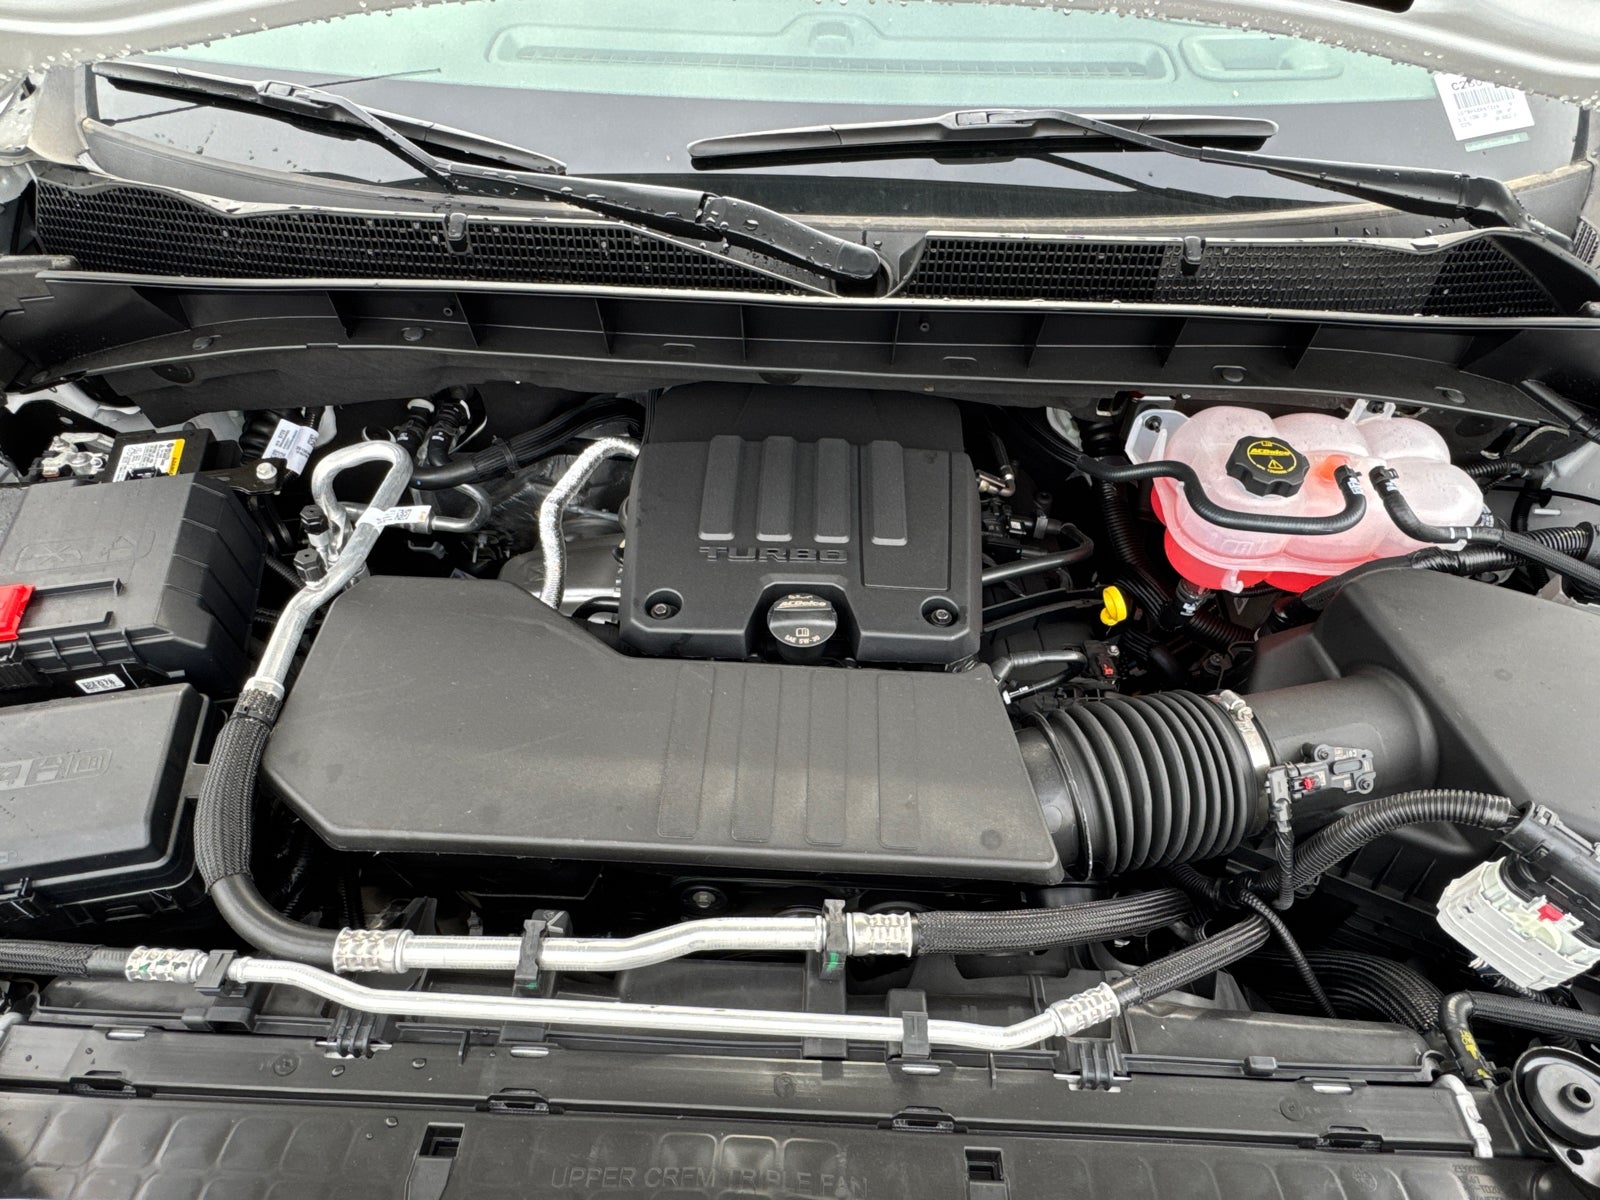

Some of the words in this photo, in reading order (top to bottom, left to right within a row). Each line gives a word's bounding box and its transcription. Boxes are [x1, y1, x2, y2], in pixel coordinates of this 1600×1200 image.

[699, 546, 849, 564] TURBO
[776, 600, 827, 609] ACDelco
[551, 1166, 637, 1189] UPPER
[819, 1173, 869, 1199] FAN
